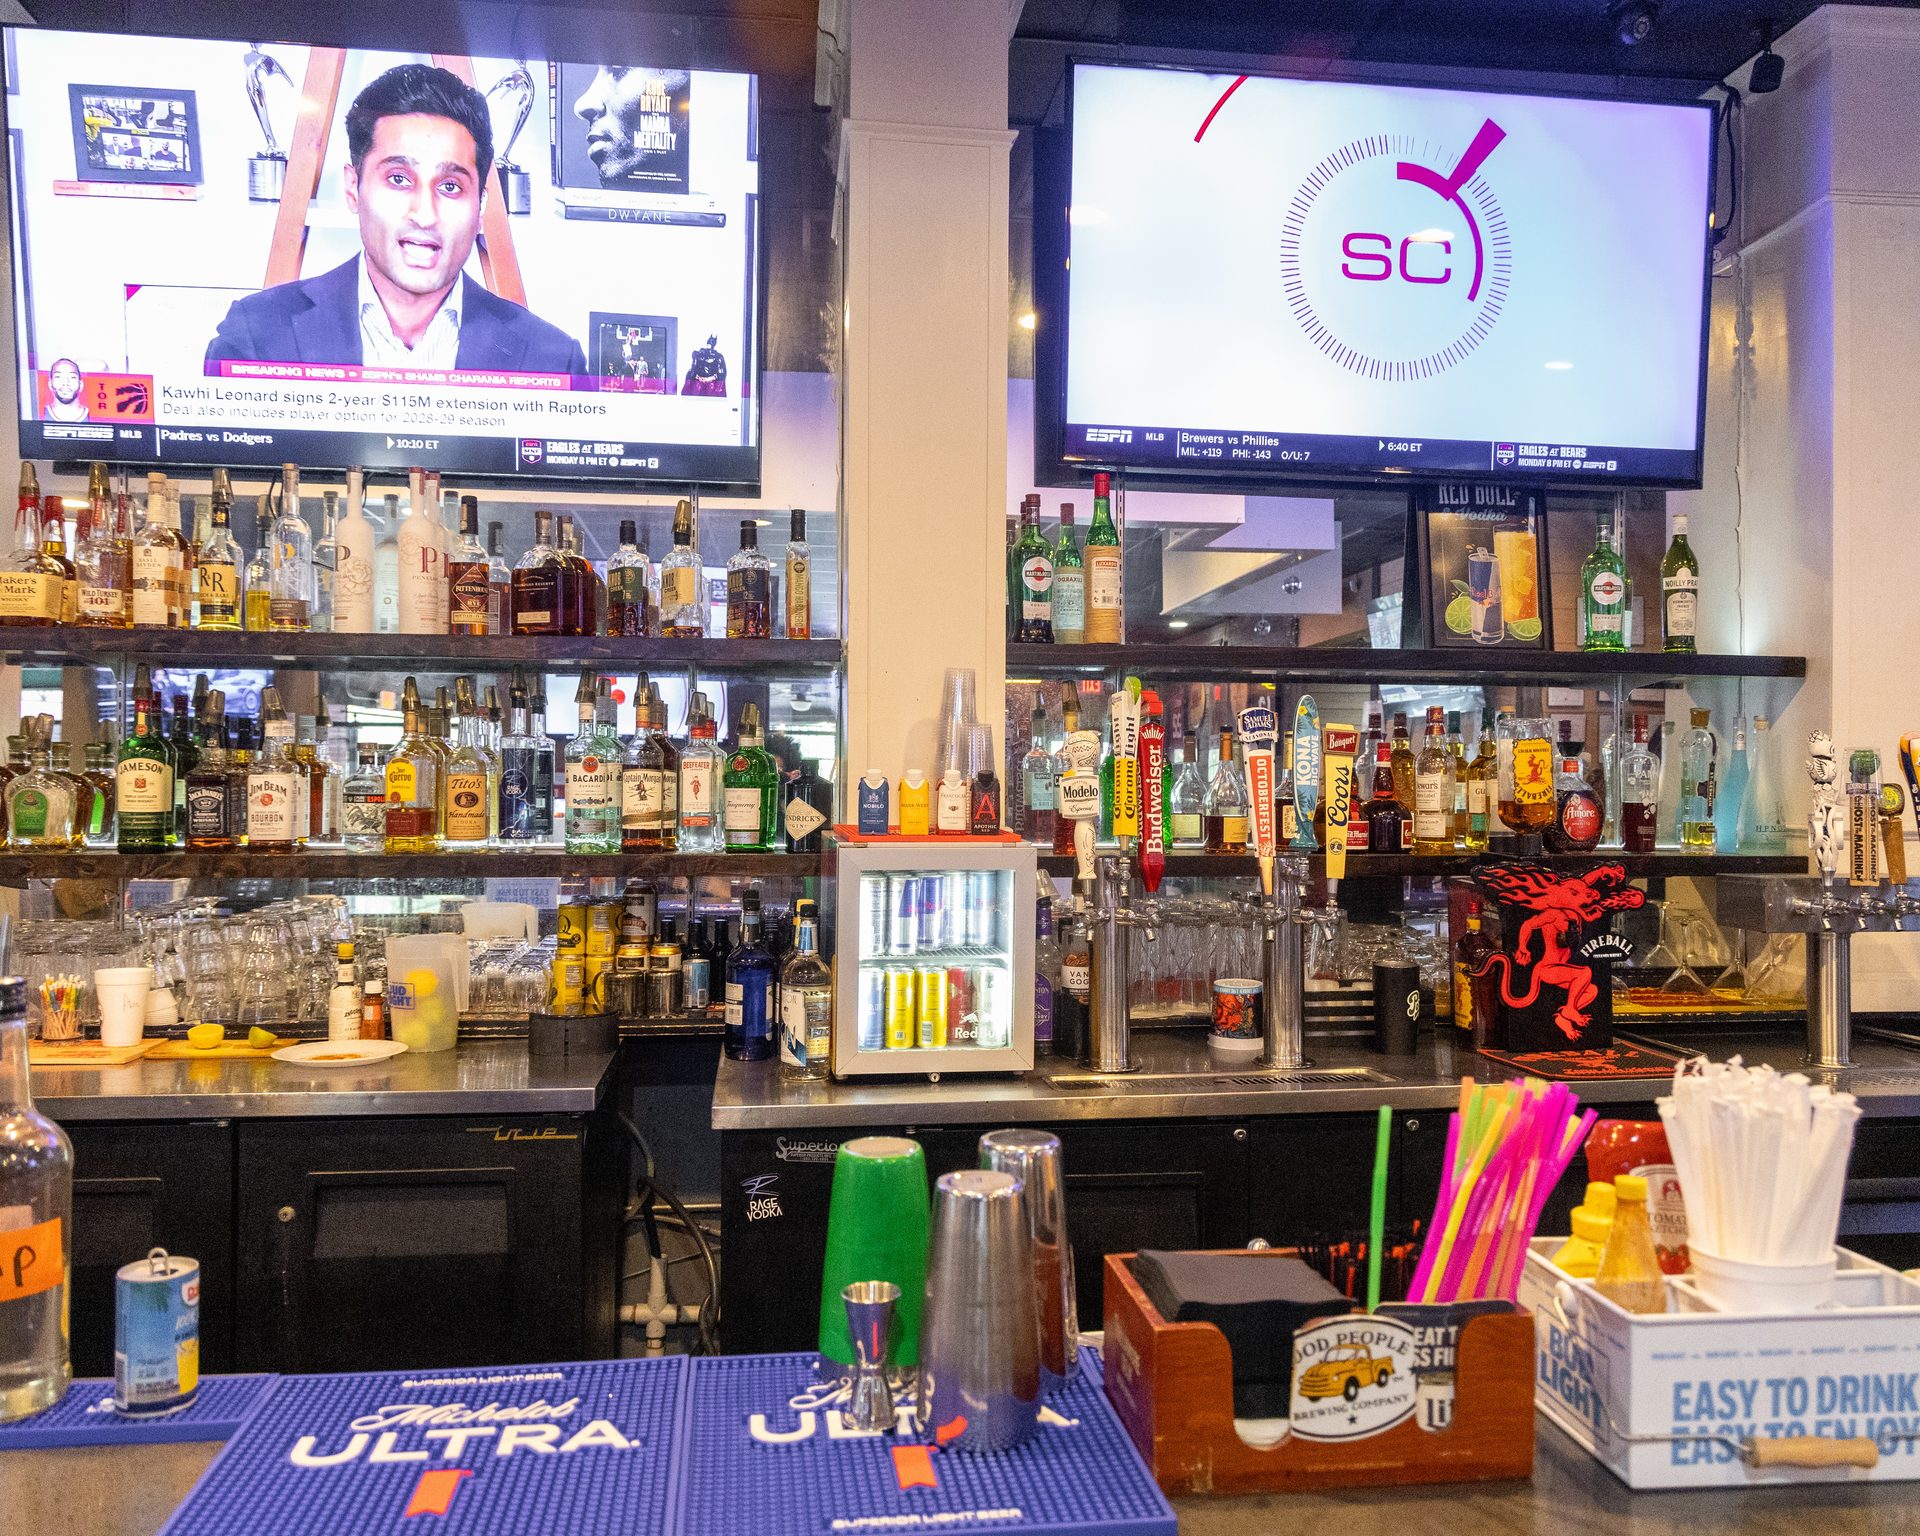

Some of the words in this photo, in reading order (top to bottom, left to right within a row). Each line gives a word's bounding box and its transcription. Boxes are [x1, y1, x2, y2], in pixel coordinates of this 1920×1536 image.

[633, 130, 677, 151] MENTALITY
[608, 208, 672, 223] DWYANE
[1341, 232, 1452, 285] SC
[231, 364, 302, 377] BREAKING
[305, 367, 345, 379] NEWS
[404, 372, 447, 383] SHAMS
[448, 374, 507, 385] CHARANIA
[508, 376, 561, 387] REPORTS
[162, 386, 210, 400] Kawhi
[215, 387, 278, 403] Leonard
[283, 391, 323, 406] signs
[328, 392, 376, 408] 2-year
[381, 394, 431, 408] $115M
[436, 396, 508, 411] extension
[512, 399, 544, 412] with
[548, 400, 607, 416] Raptors
[162, 403, 192, 415] Deal
[197, 404, 225, 416] also
[229, 405, 285, 419] includes
[289, 408, 328, 422] player
[334, 410, 375, 423] option
[380, 411, 397, 422] for
[459, 415, 506, 426] season
[119, 429, 143, 439] MLB
[161, 429, 203, 442] Padres
[205, 432, 220, 442] vs
[223, 431, 274, 445] Dodgers
[1085, 428, 1133, 443] ESPN
[1145, 432, 1165, 441] MLB
[1181, 432, 1224, 444] Brewers
[1227, 435, 1239, 445] vs
[1242, 435, 1280, 446] Phillies
[396, 438, 424, 449] 10:10
[425, 439, 439, 450] ET
[546, 441, 581, 454] EAGLES
[593, 443, 624, 456] BEARS
[1387, 442, 1409, 452] 6:40
[1409, 442, 1423, 453] ET
[1518, 444, 1549, 457] EAGLES
[1549, 447, 1559, 457] AT
[1560, 446, 1587, 458] BEARS
[546, 455, 579, 465] MONDAY
[578, 456, 585, 465] 8
[585, 457, 598, 466] PM
[598, 457, 608, 466] ET
[1180, 446, 1200, 457] MIL:
[1202, 447, 1223, 458] +119
[1232, 448, 1250, 459] PHI:
[1252, 449, 1272, 460] -143
[1281, 450, 1303, 461] O/U:
[1303, 452, 1310, 461] 7
[1518, 458, 1546, 468] MONDAY
[1546, 459, 1552, 468] 8
[1552, 459, 1563, 468] PM
[1563, 459, 1572, 468] ET
[1475, 485, 1516, 507] BULL
[1455, 507, 1508, 521] Vodka
[4, 585, 37, 594] Mark
[1665, 579, 1685, 588] NOILLY
[82, 589, 96, 597] WILD
[88, 597, 110, 606] 101
[1243, 714, 1274, 724] SAMUEL
[1245, 720, 1272, 730] ADAMS
[1124, 716, 1136, 758] Light
[1243, 732, 1274, 741] SEASONAL
[1329, 732, 1356, 749] Banquet
[1310, 735, 1319, 766] WAVE
[683, 761, 710, 769] BEEFEATER
[1296, 735, 1311, 786] KONA
[119, 762, 164, 775] JAMESON
[1310, 766, 1319, 786] BIG
[388, 772, 412, 784] Cuervo
[451, 778, 482, 790] Tito's
[623, 773, 642, 784] Captain
[642, 773, 663, 785] Morgan
[188, 790, 202, 801] JACK
[249, 783, 263, 797] JIM
[263, 780, 287, 797] BEAM
[1063, 785, 1099, 799] Modelo
[1124, 760, 1137, 819] Corona
[1327, 764, 1350, 827] Coors
[1515, 782, 1553, 800] FIREBALL
[727, 800, 756, 809] Tanqueray
[1145, 745, 1164, 855] Budweiser
[1255, 758, 1270, 839] OCTOBERFEST
[448, 809, 486, 819] Handmade
[974, 794, 997, 820] A
[1566, 806, 1595, 819] Amore
[250, 814, 284, 823] BOURBON
[786, 814, 821, 823] ENDRICK'S
[1854, 834, 1864, 875] MACHINE
[1579, 933, 1634, 958] FIREBALL
[1069, 970, 1089, 978] VAN
[954, 1027, 977, 1039] Red
[775, 1136, 838, 1158] Superio
[749, 1197, 778, 1211] RAGE
[746, 1206, 783, 1222] VODKA
[1414, 1326, 1446, 1346] EAT
[1295, 1337, 1329, 1364] OD
[1336, 1330, 1410, 1356] PEOPLE
[401, 1376, 477, 1388] SUPERIOR
[478, 1374, 525, 1385] LIGHT
[524, 1372, 563, 1382] BEER
[1540, 1350, 1601, 1428] LIGHT
[1672, 1379, 1760, 1423] EASY
[1765, 1377, 1809, 1419] TO
[1816, 1372, 1919, 1416] DRINK
[350, 1397, 581, 1431] Michelob
[1293, 1403, 1349, 1422] BREWING
[1351, 1393, 1410, 1412] COMPANY
[831, 1513, 921, 1530] SUPERIOR
[922, 1510, 975, 1526] LIGHT
[975, 1507, 1022, 1522] BEER
